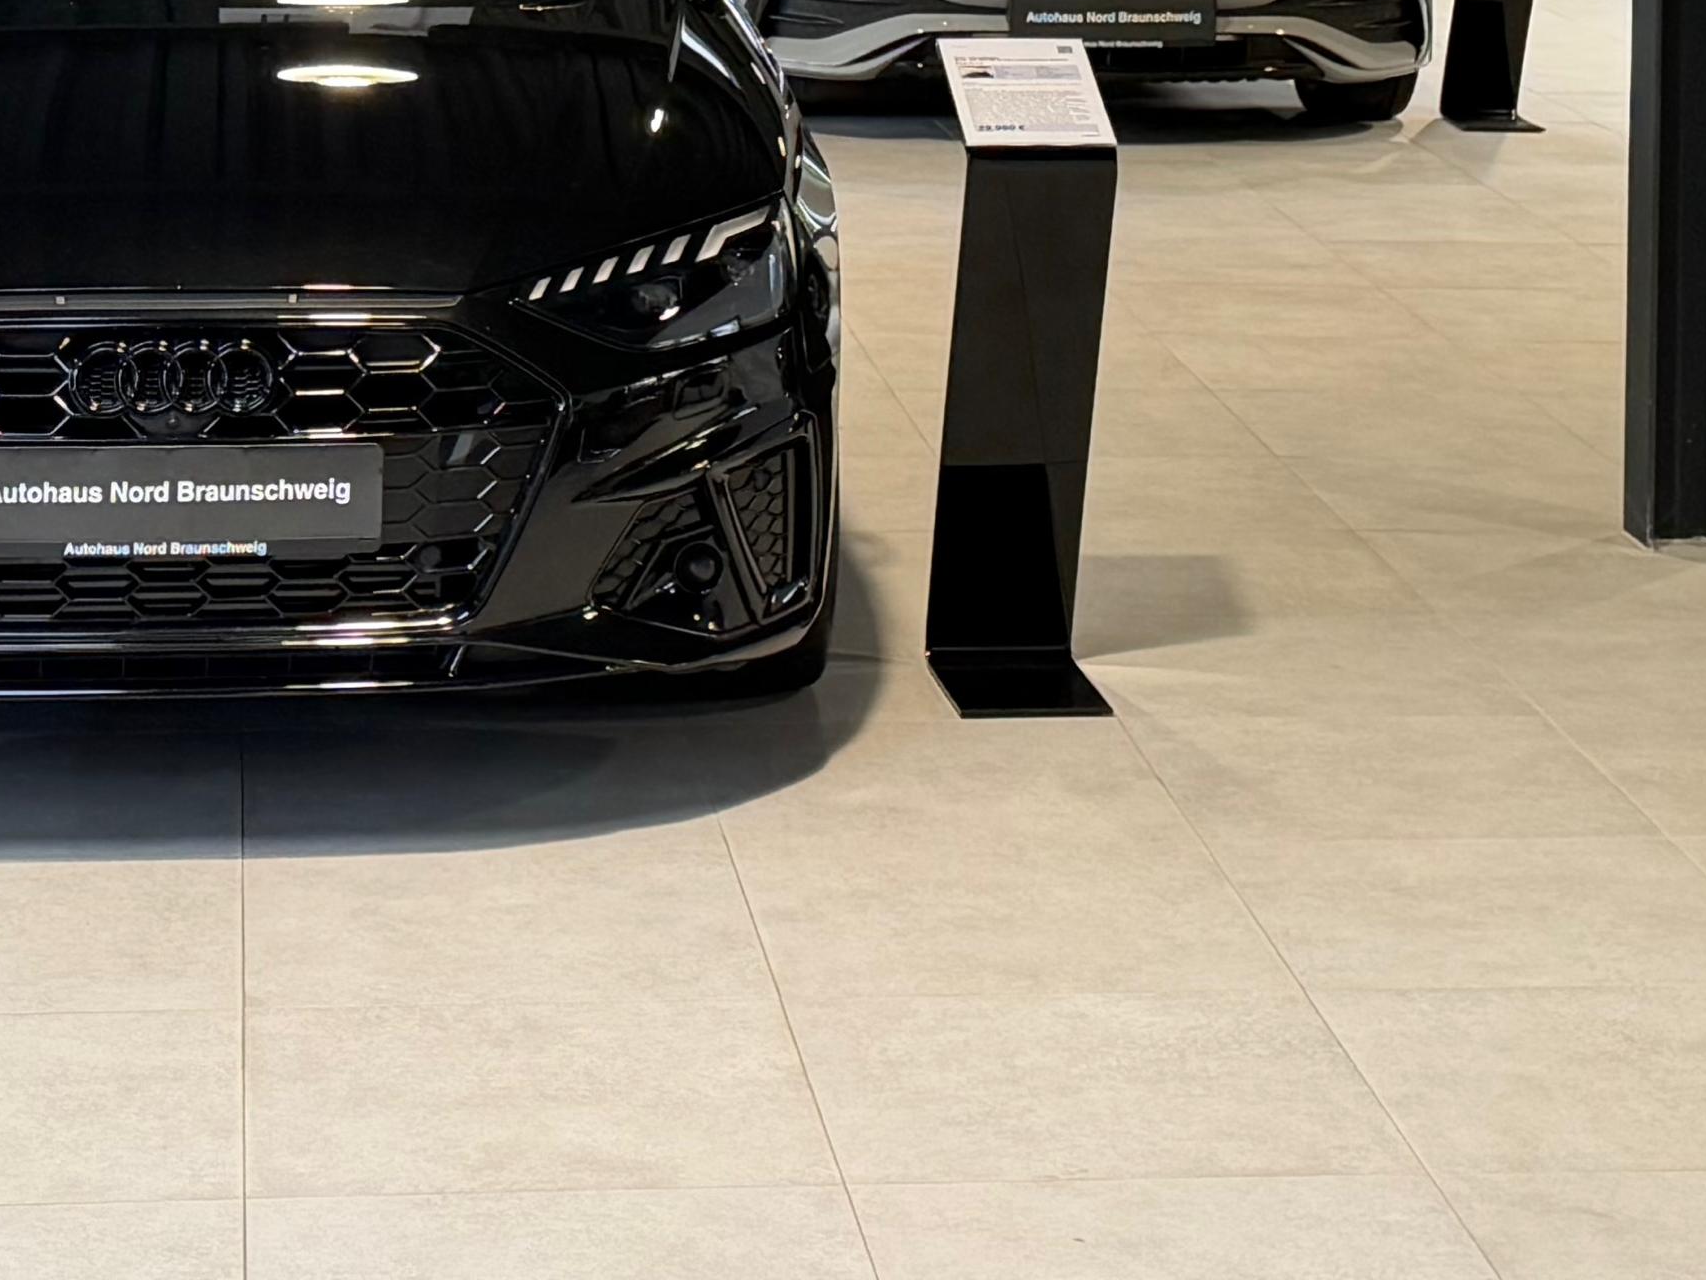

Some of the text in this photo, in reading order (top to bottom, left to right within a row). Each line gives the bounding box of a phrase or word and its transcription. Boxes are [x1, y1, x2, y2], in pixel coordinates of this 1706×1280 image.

[1026, 11, 1202, 25] Autohaus Nord Braunschweig
[109, 480, 170, 504] Nord
[176, 477, 351, 505] Braunschweig
[63, 540, 267, 557] Autohaus Nord Braunschweig
